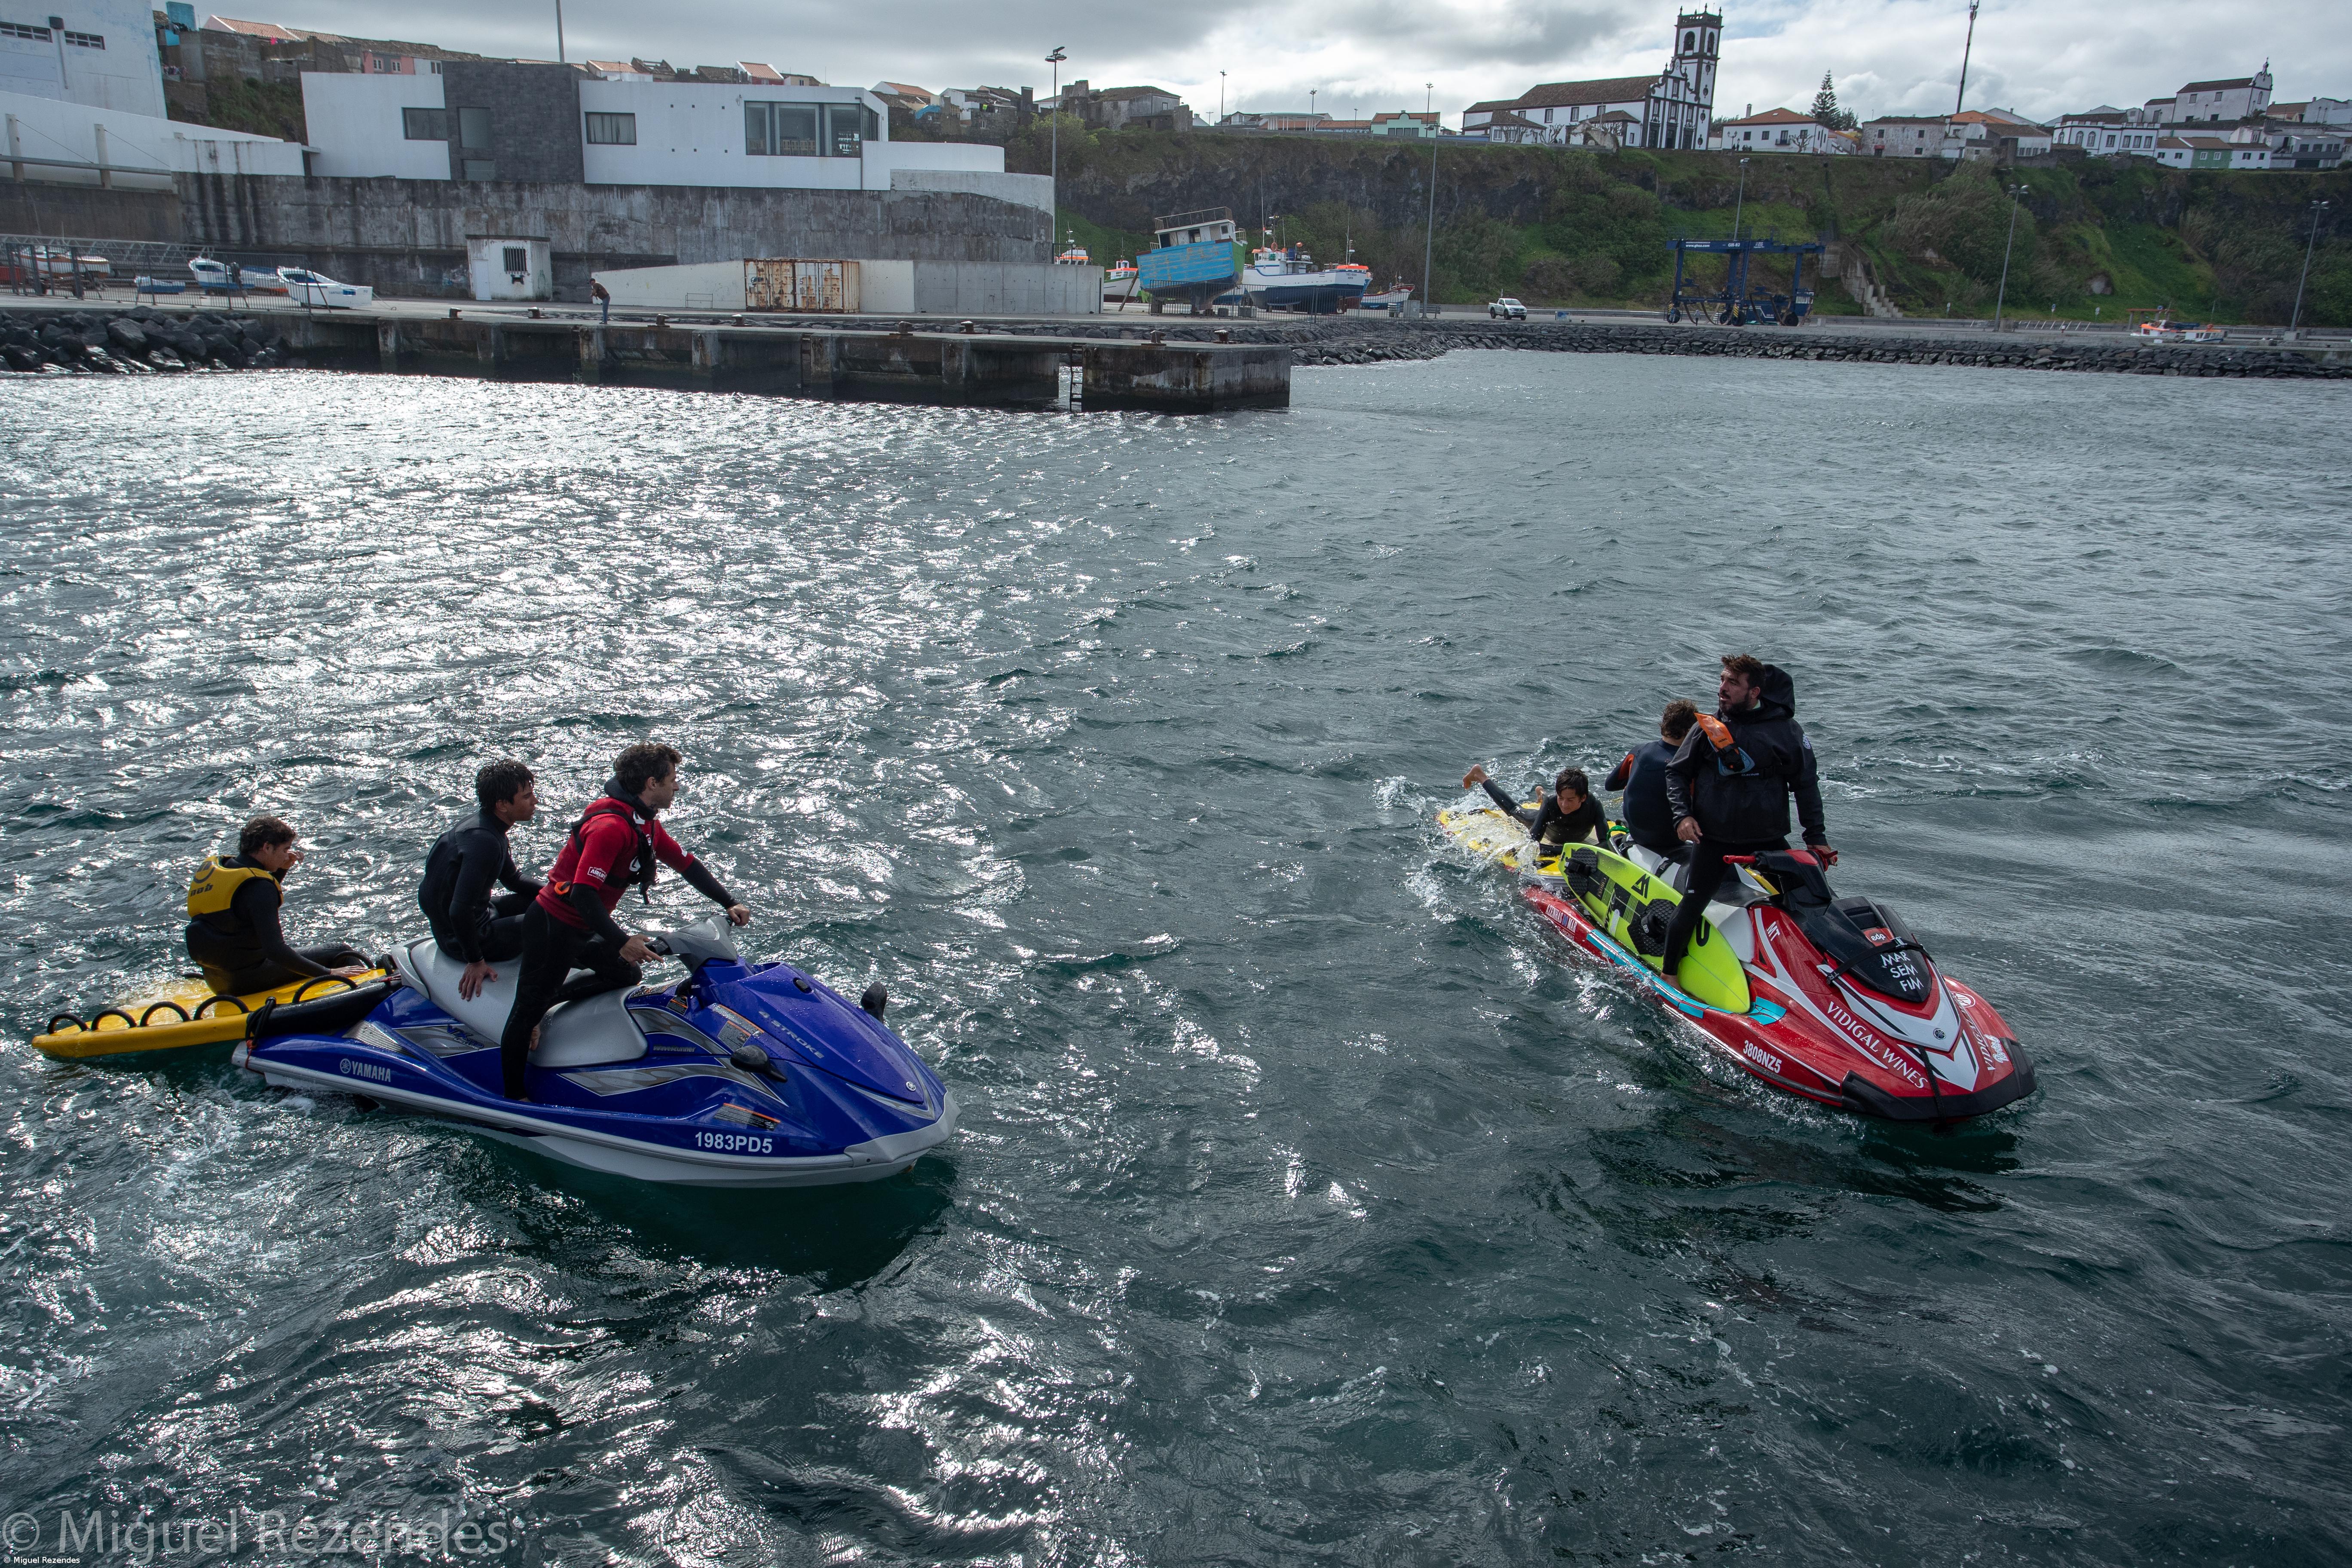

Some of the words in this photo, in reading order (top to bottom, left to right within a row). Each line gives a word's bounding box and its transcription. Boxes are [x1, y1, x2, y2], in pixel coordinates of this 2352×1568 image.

[1545, 904, 1564, 924] AZENHAS
[1562, 914, 1569, 927] DO
[1567, 917, 1577, 933] MAR
[1767, 921, 1780, 941] MT
[1880, 952, 1911, 967] MAR
[1890, 963, 1919, 978] SEM
[1899, 977, 1924, 992] FIM
[771, 1020, 825, 1059] STROKE
[1828, 1001, 1880, 1052] VIDIGAL
[1883, 1047, 1928, 1089] WINES
[1743, 1040, 1782, 1073] 3808NZ5
[352, 1061, 391, 1082] YAMAHA
[695, 1131, 773, 1154] 1983PD5
